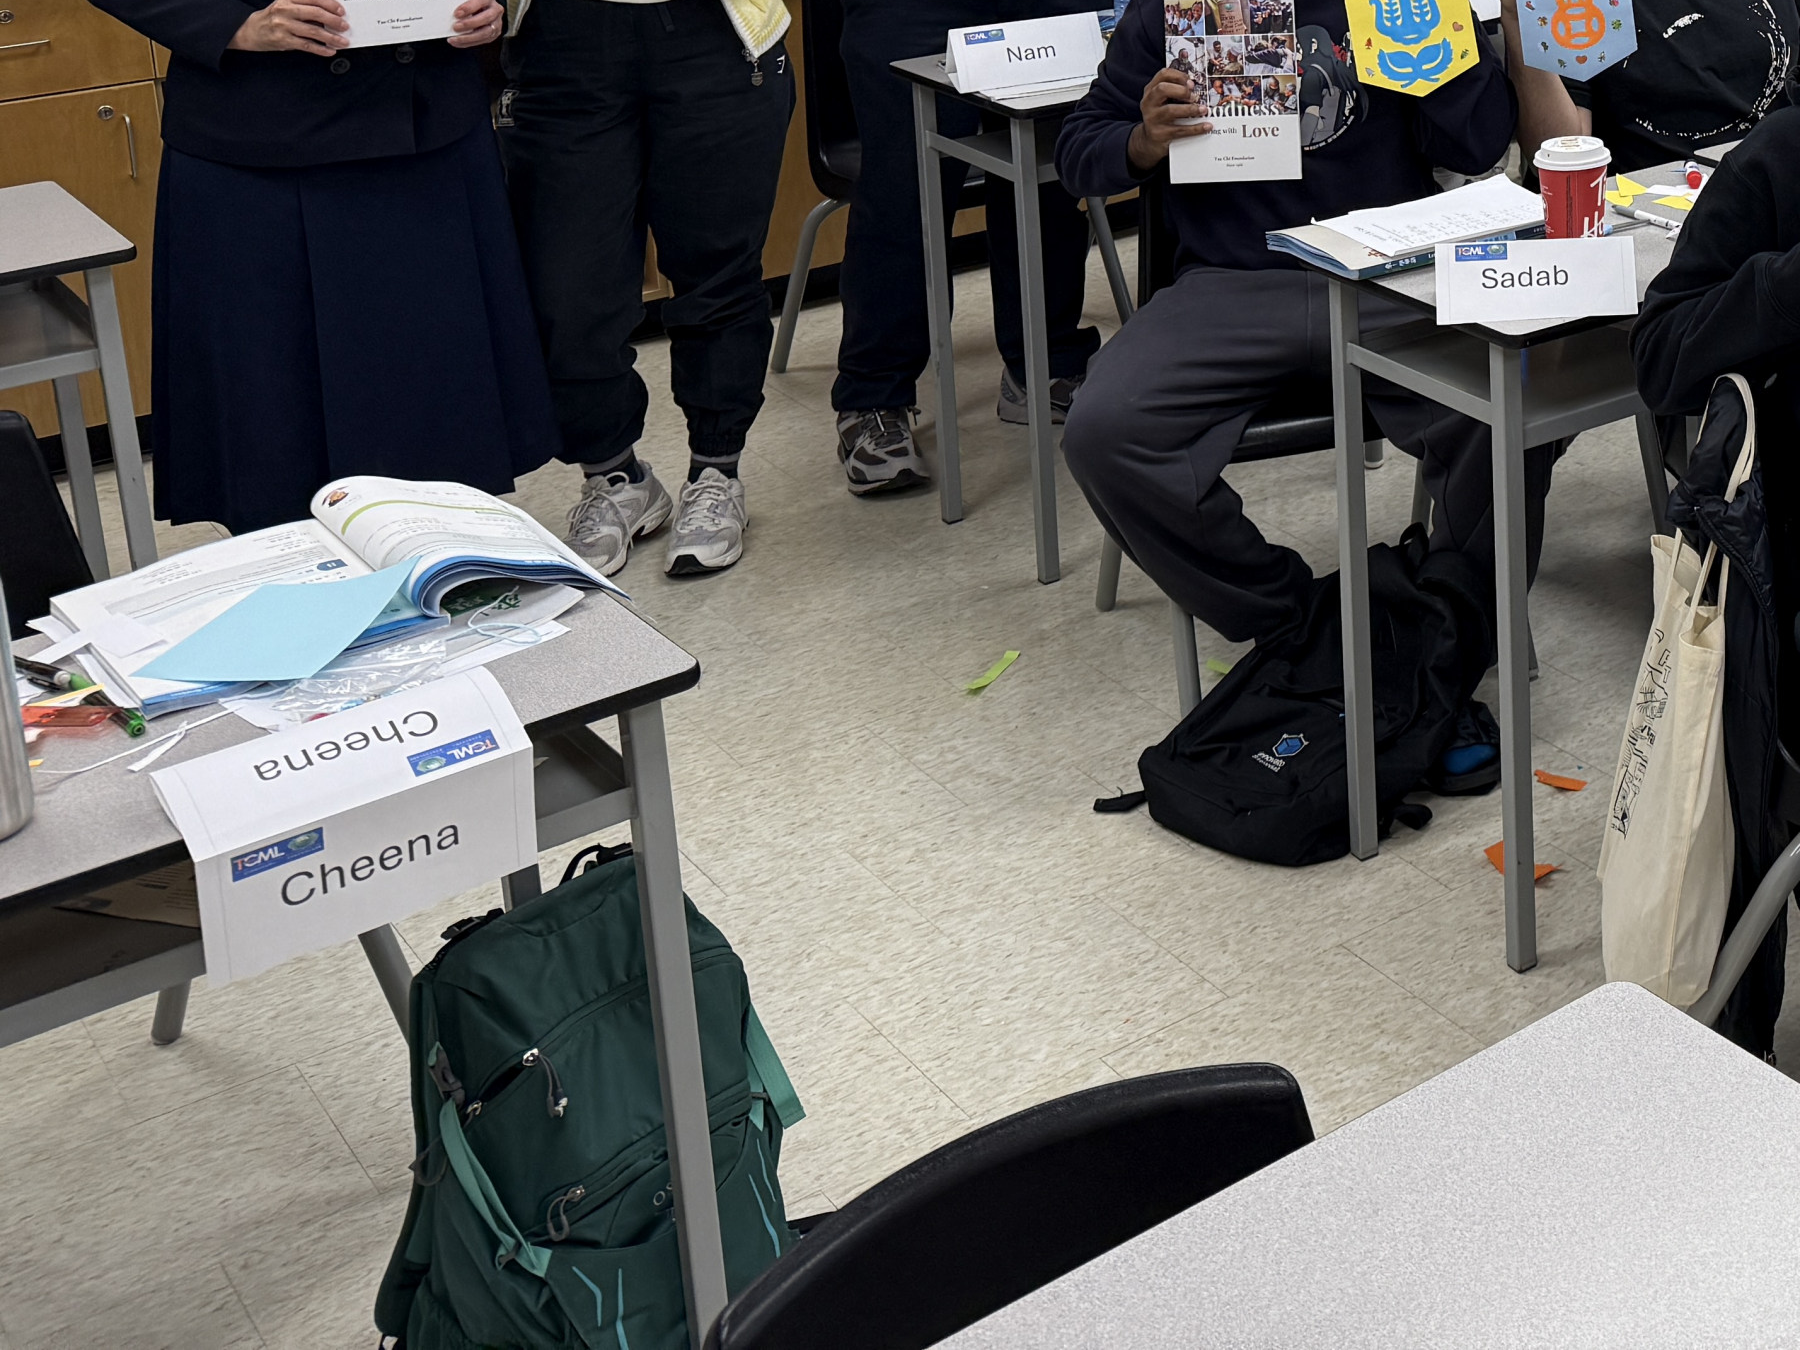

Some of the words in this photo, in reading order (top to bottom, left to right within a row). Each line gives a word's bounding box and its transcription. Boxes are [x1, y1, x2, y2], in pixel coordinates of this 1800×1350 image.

[1006, 45, 1056, 63] Nam
[1202, 101, 1279, 118] oodness
[1222, 127, 1238, 135] with
[1242, 124, 1280, 138] Love
[1457, 247, 1485, 256] TCML
[1481, 265, 1569, 289] Sadab
[254, 710, 438, 781] Cheena
[447, 737, 497, 761] TCML
[232, 844, 286, 872] TCML
[281, 824, 460, 906] Cheena
